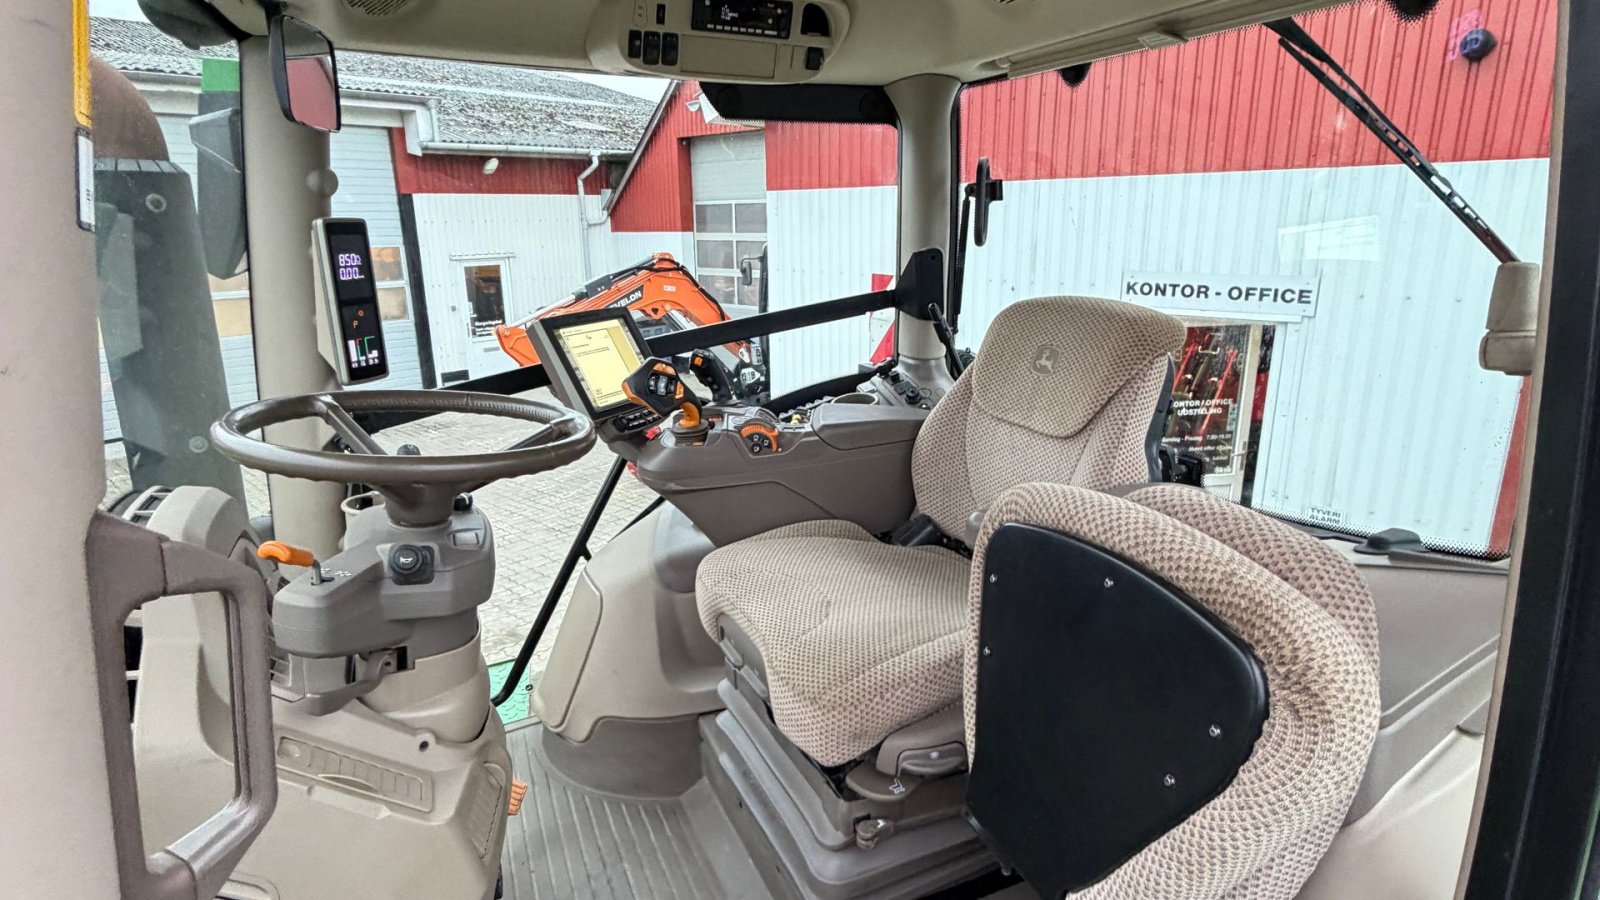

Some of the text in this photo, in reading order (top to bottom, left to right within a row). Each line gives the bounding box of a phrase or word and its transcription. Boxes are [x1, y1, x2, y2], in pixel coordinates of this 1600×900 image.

[609, 290, 642, 308] VELON
[1126, 281, 1210, 299] KONTOR
[1227, 286, 1313, 304] OFFICE
[1173, 400, 1200, 408] ONTOR
